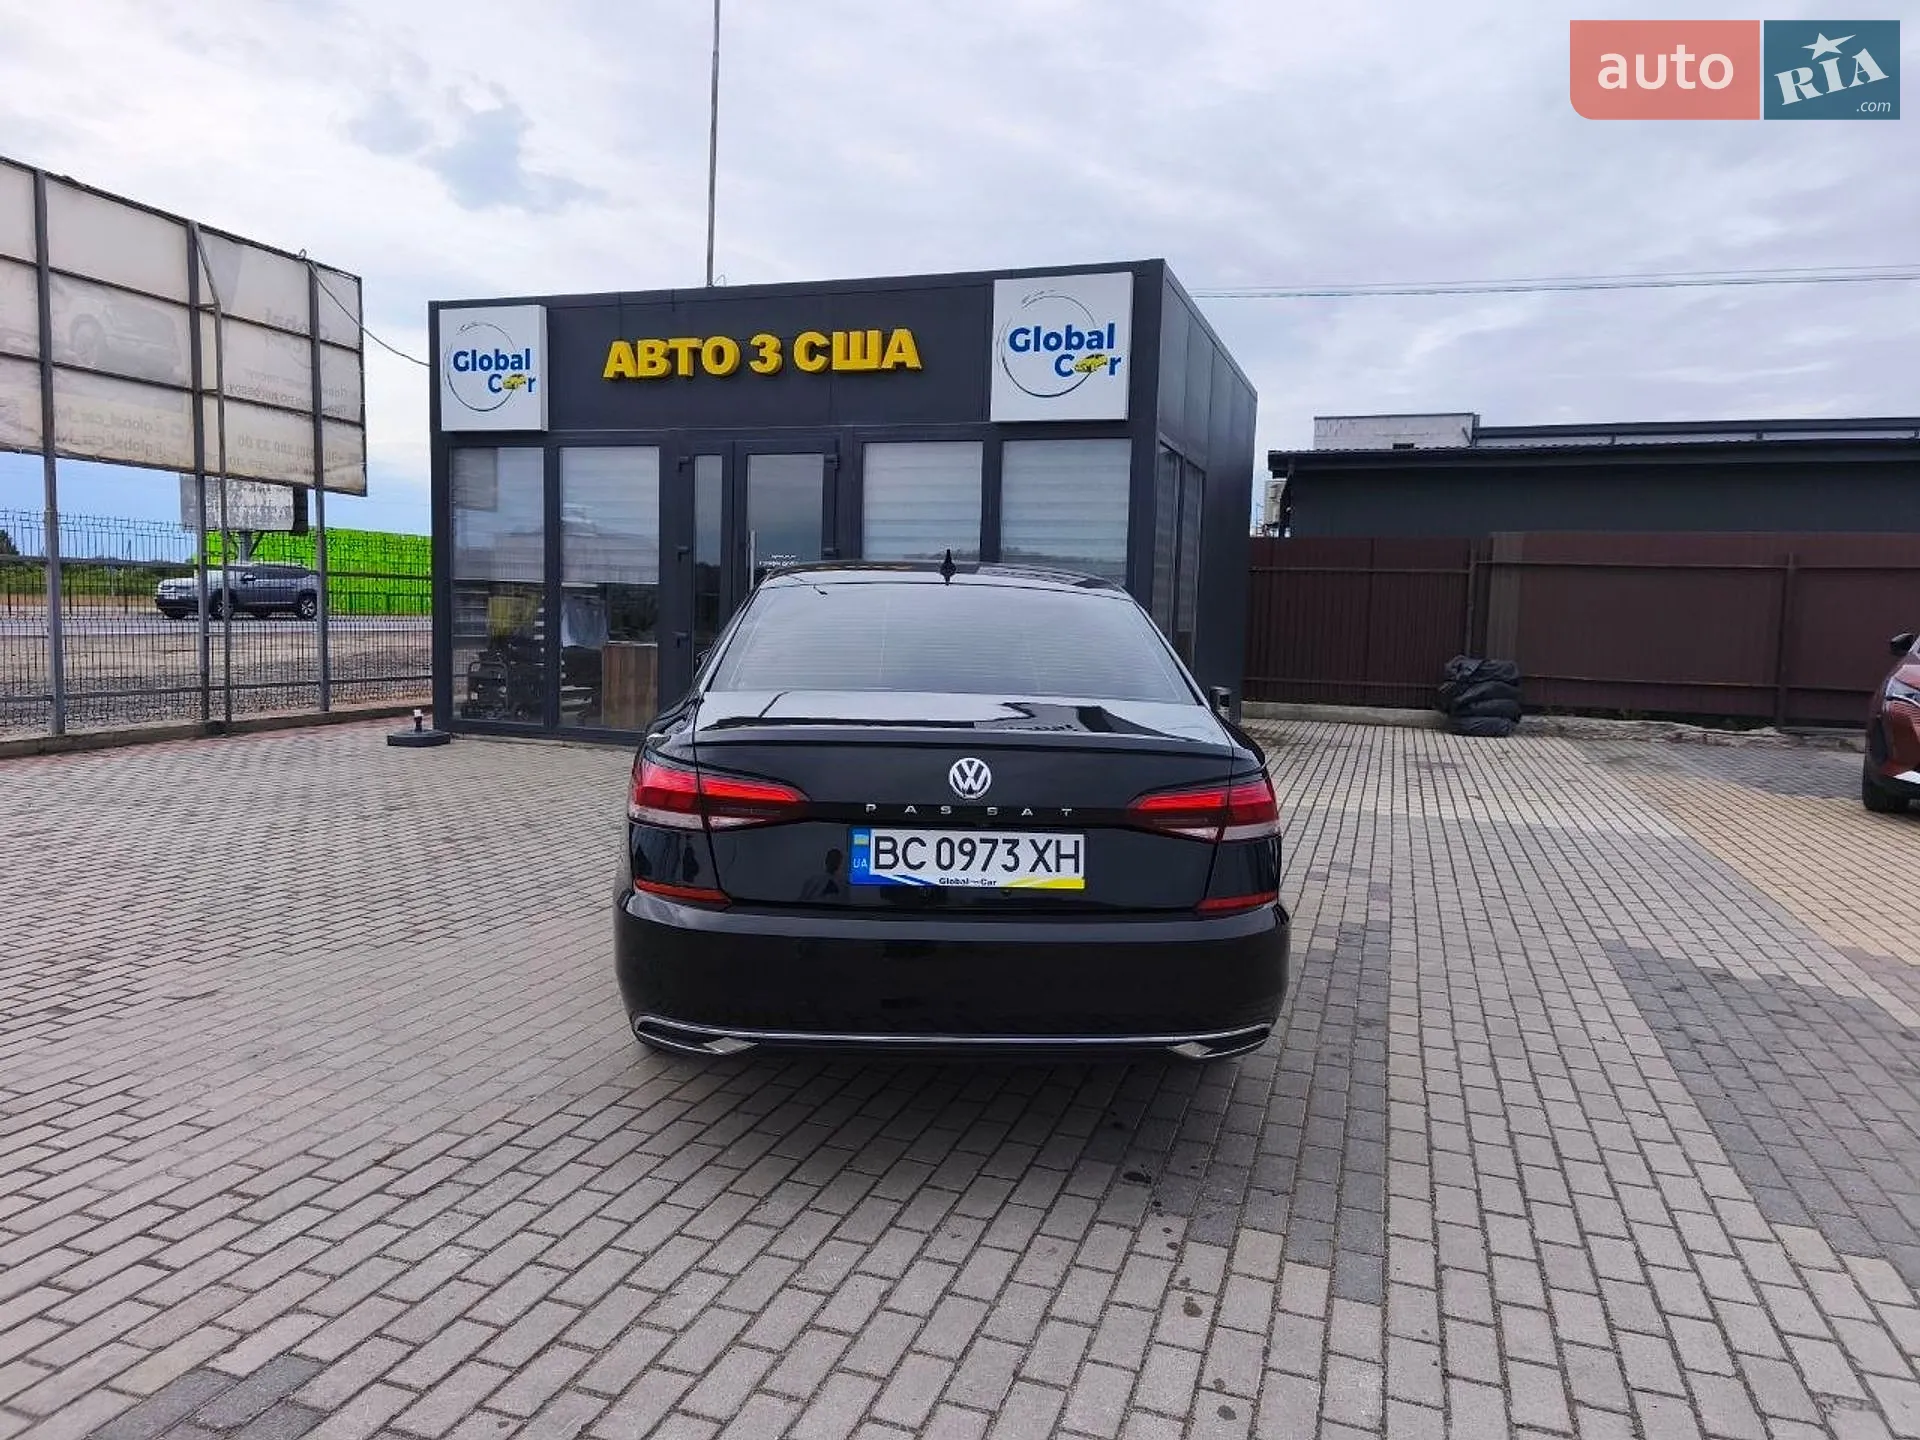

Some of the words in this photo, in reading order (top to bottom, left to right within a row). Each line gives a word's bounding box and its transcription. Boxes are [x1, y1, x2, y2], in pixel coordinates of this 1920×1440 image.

[1009, 322, 1115, 353] Global
[453, 348, 531, 372] Global
[603, 335, 741, 379] АВТО
[793, 328, 923, 373] США
[1054, 353, 1121, 377] Cr
[487, 373, 536, 393] Cr
[865, 803, 1073, 817] PASSAT
[852, 857, 868, 869] UA
[873, 835, 927, 871] BC
[935, 836, 1020, 873] 0973
[1029, 838, 1080, 874] XH
[938, 876, 970, 886] Global
[980, 878, 997, 887] Car
